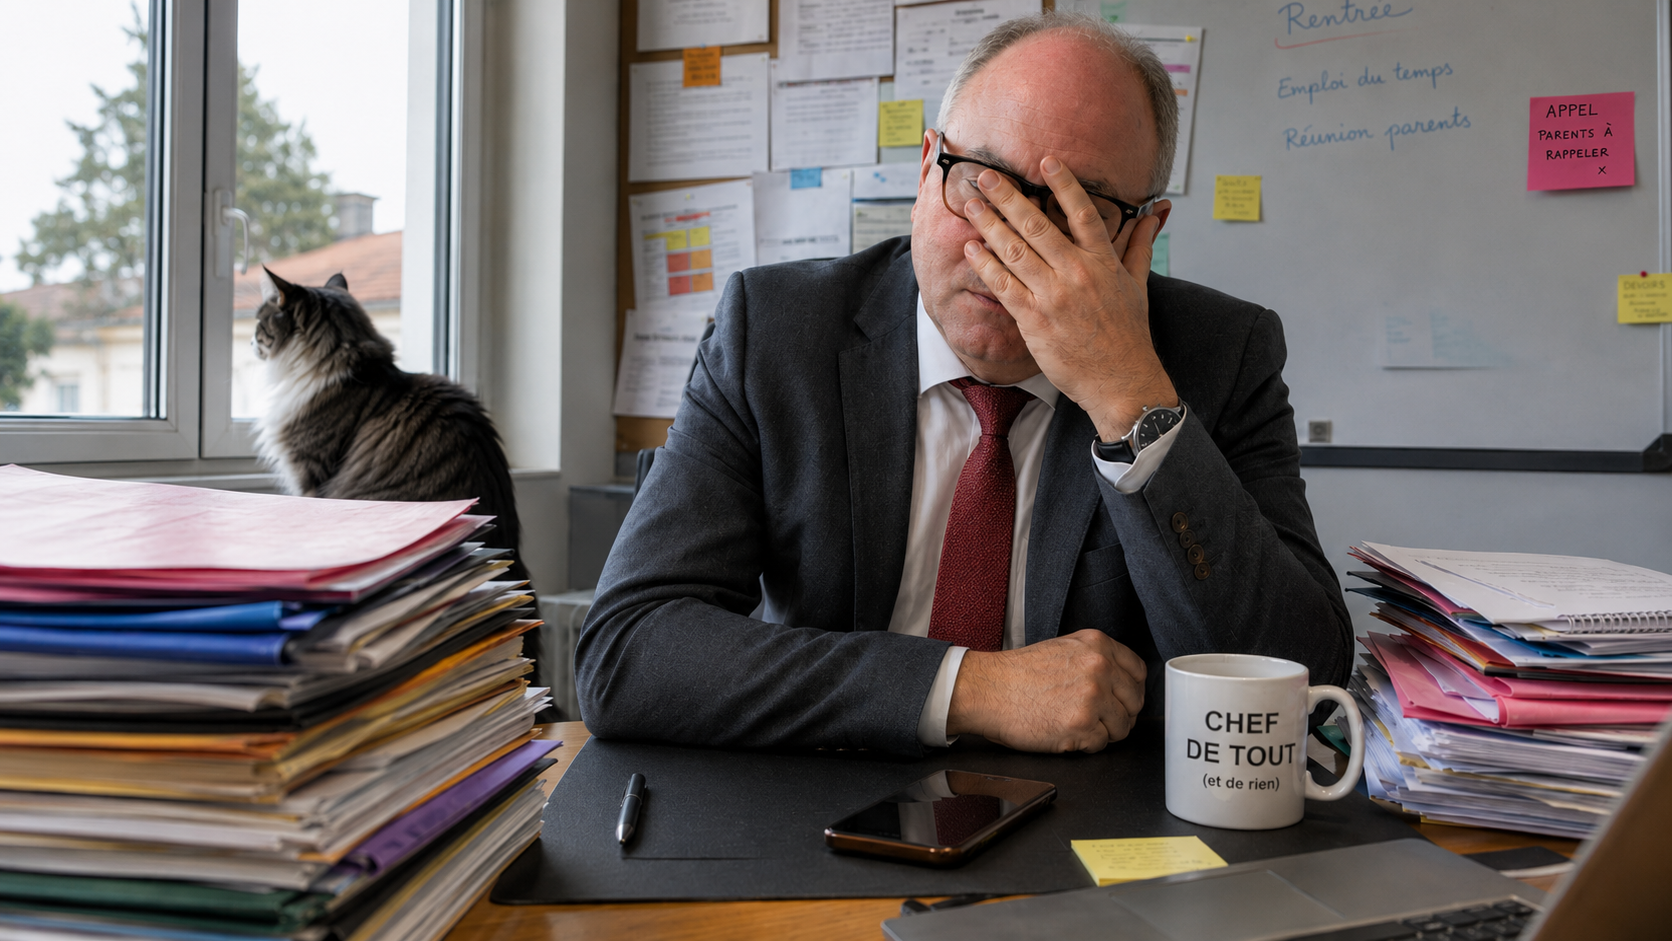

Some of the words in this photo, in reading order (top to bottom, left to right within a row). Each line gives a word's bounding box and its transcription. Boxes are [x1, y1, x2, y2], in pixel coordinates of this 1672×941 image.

[1278, 69, 1348, 105] Emploi
[1357, 66, 1386, 87] du
[1392, 61, 1454, 89] temps
[1545, 103, 1599, 119] APPEL
[1283, 122, 1374, 151] Réunion
[1384, 106, 1472, 151] parents
[1538, 128, 1595, 141] PARENTS
[1603, 122, 1613, 138] À
[1546, 147, 1610, 160] RAPPELER
[1623, 280, 1666, 290] DEVOIRS
[1205, 710, 1280, 734] CHEF
[1187, 738, 1220, 764] DE
[1229, 743, 1296, 767] TOUT
[1202, 772, 1222, 789] (et
[1225, 774, 1244, 790] de
[1249, 777, 1280, 792] rien)
